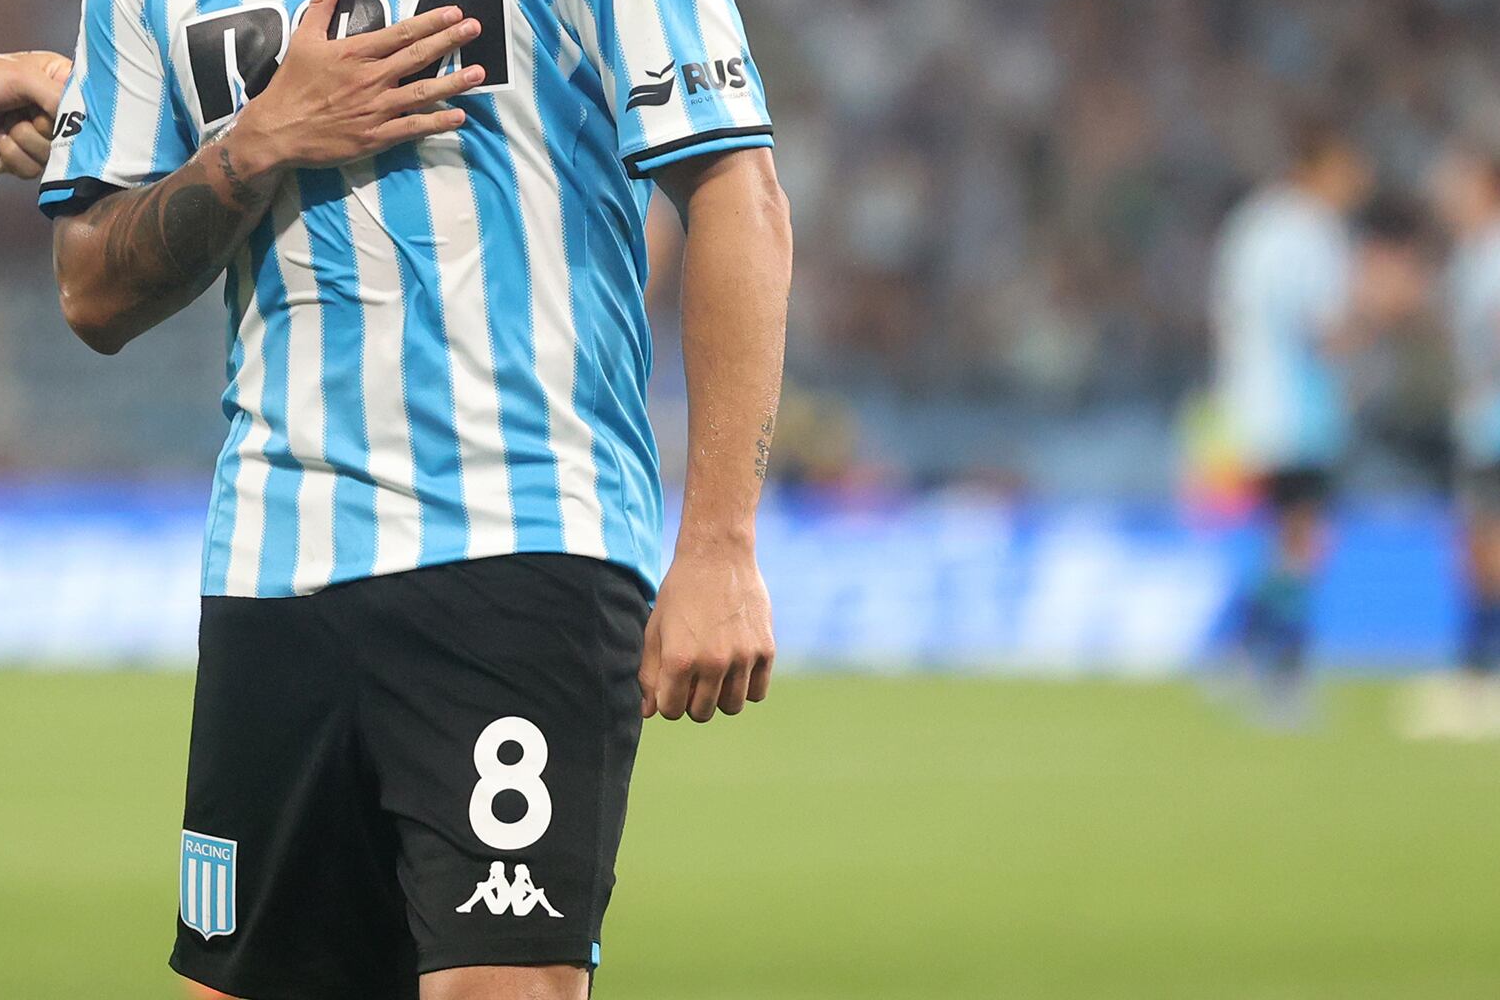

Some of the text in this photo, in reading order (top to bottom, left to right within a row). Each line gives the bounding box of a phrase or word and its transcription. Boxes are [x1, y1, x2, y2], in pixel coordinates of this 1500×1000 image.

[681, 57, 746, 95] RUS
[469, 716, 553, 850] 8
[185, 839, 231, 861] RACING
